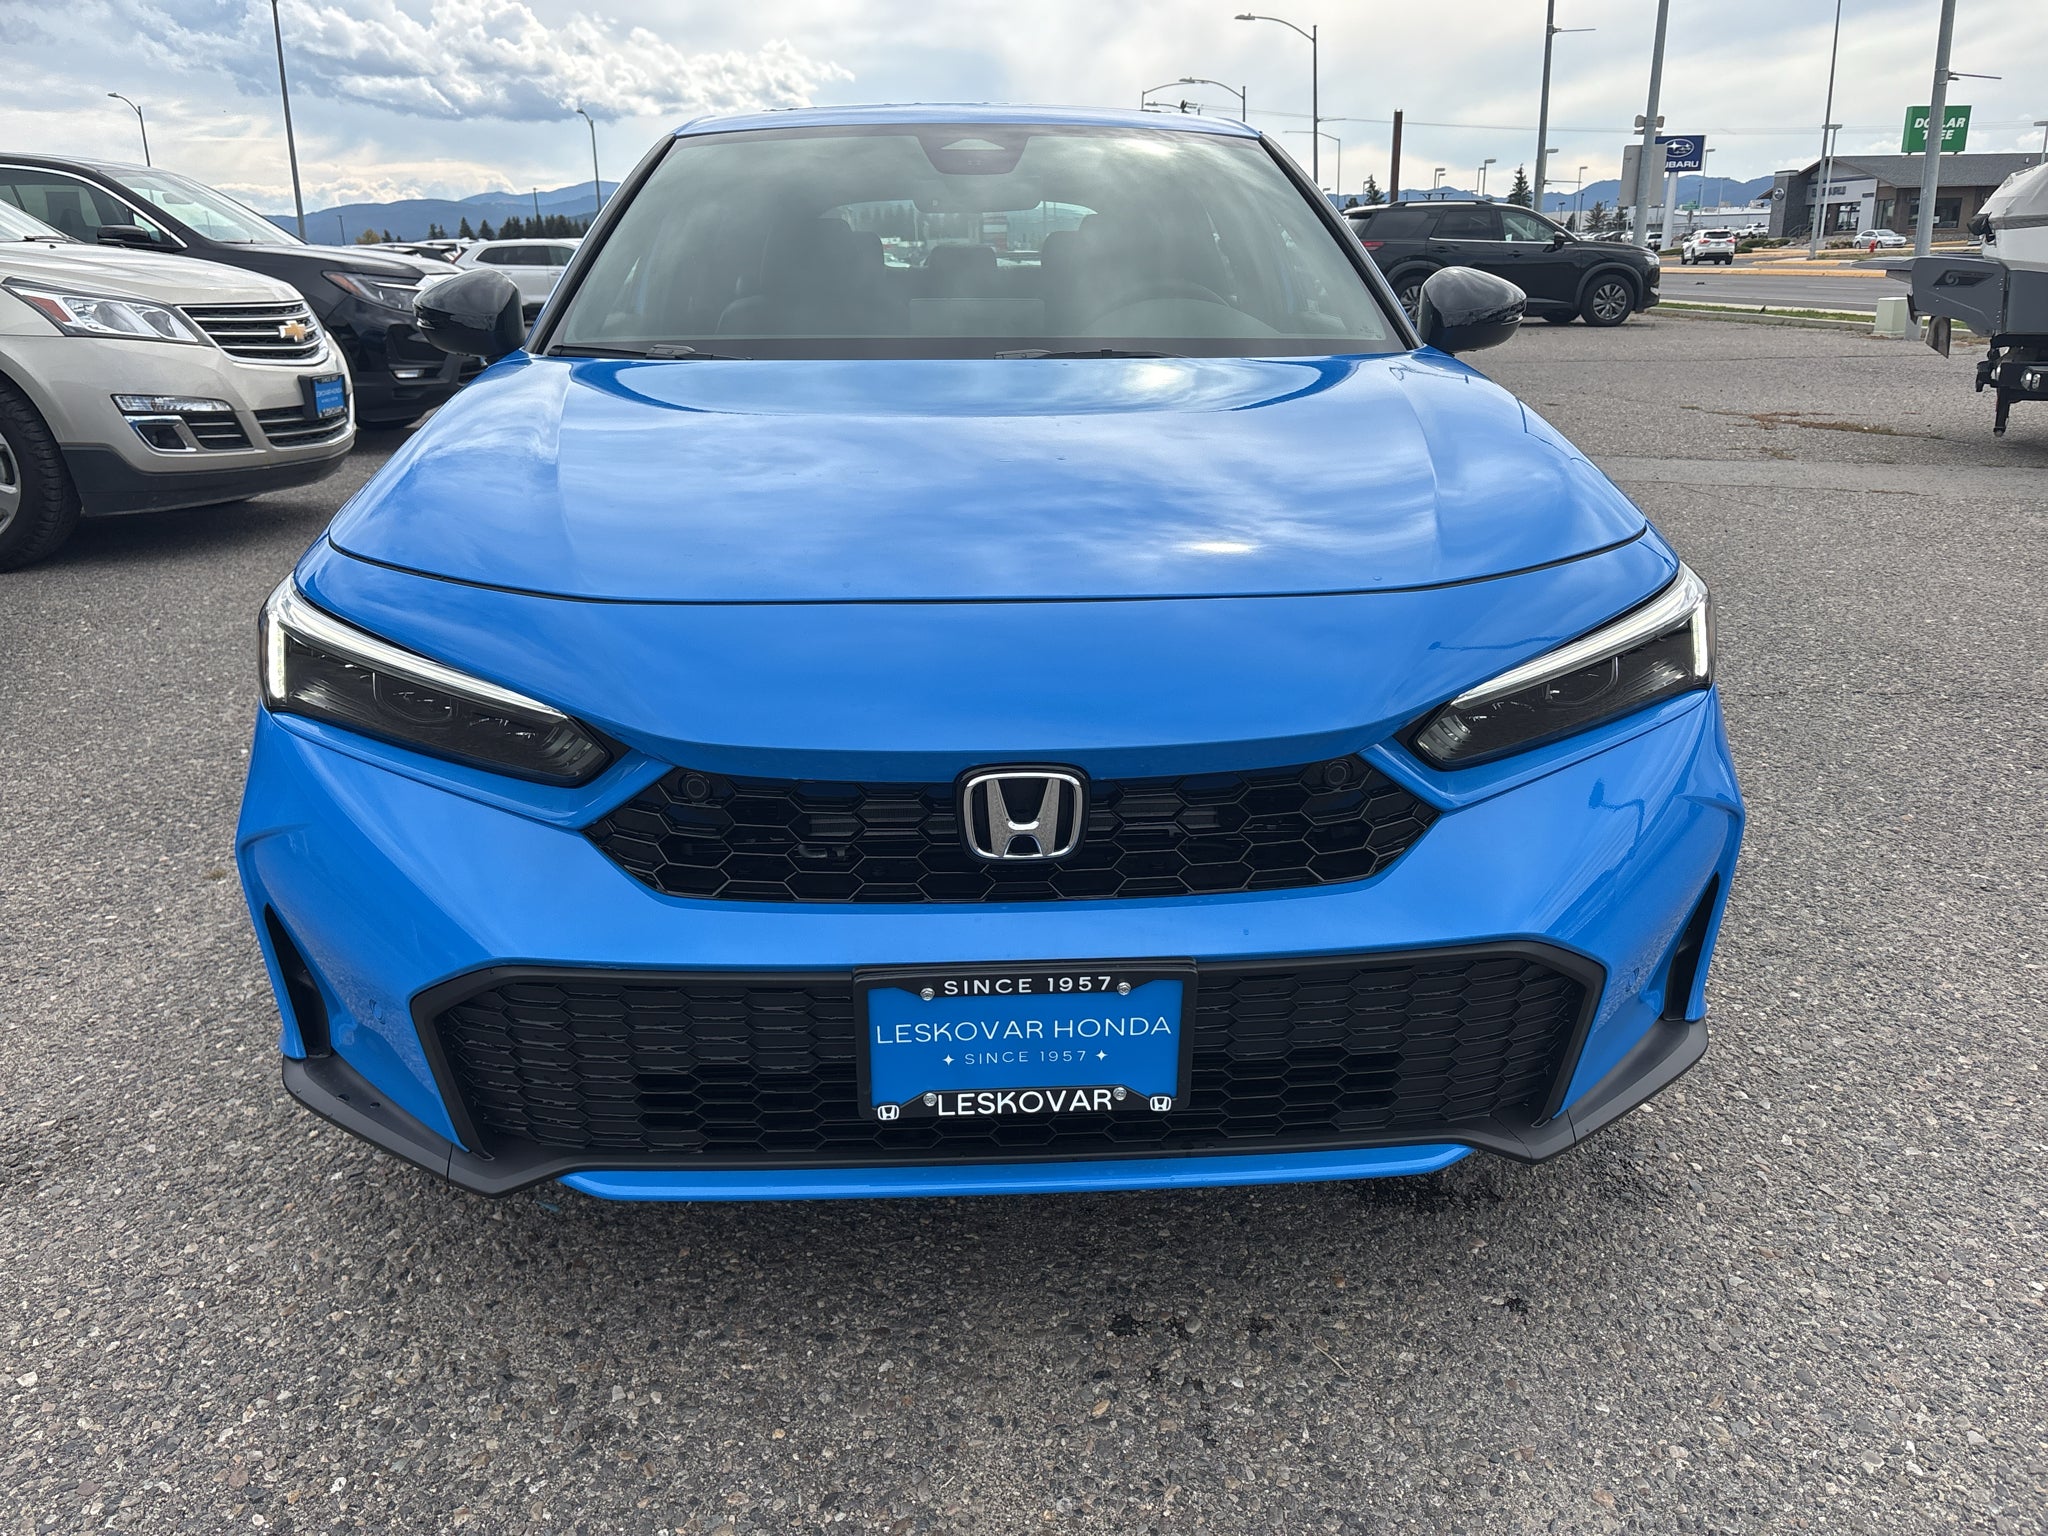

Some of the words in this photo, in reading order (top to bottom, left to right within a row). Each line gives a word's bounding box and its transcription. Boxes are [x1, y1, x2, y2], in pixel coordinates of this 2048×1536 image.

[1913, 117, 1966, 128] DOAR
[1922, 129, 1954, 140] TEE
[1665, 160, 1699, 168] BARU
[943, 978, 1033, 996] SINCE
[1047, 975, 1112, 992] 1957
[876, 1020, 1044, 1045] LESKOVAR
[1053, 1016, 1172, 1039] HONDA
[964, 1051, 1029, 1066] SINCE
[1040, 1050, 1087, 1063] 1957
[938, 1089, 1113, 1117] LESKOVAR
